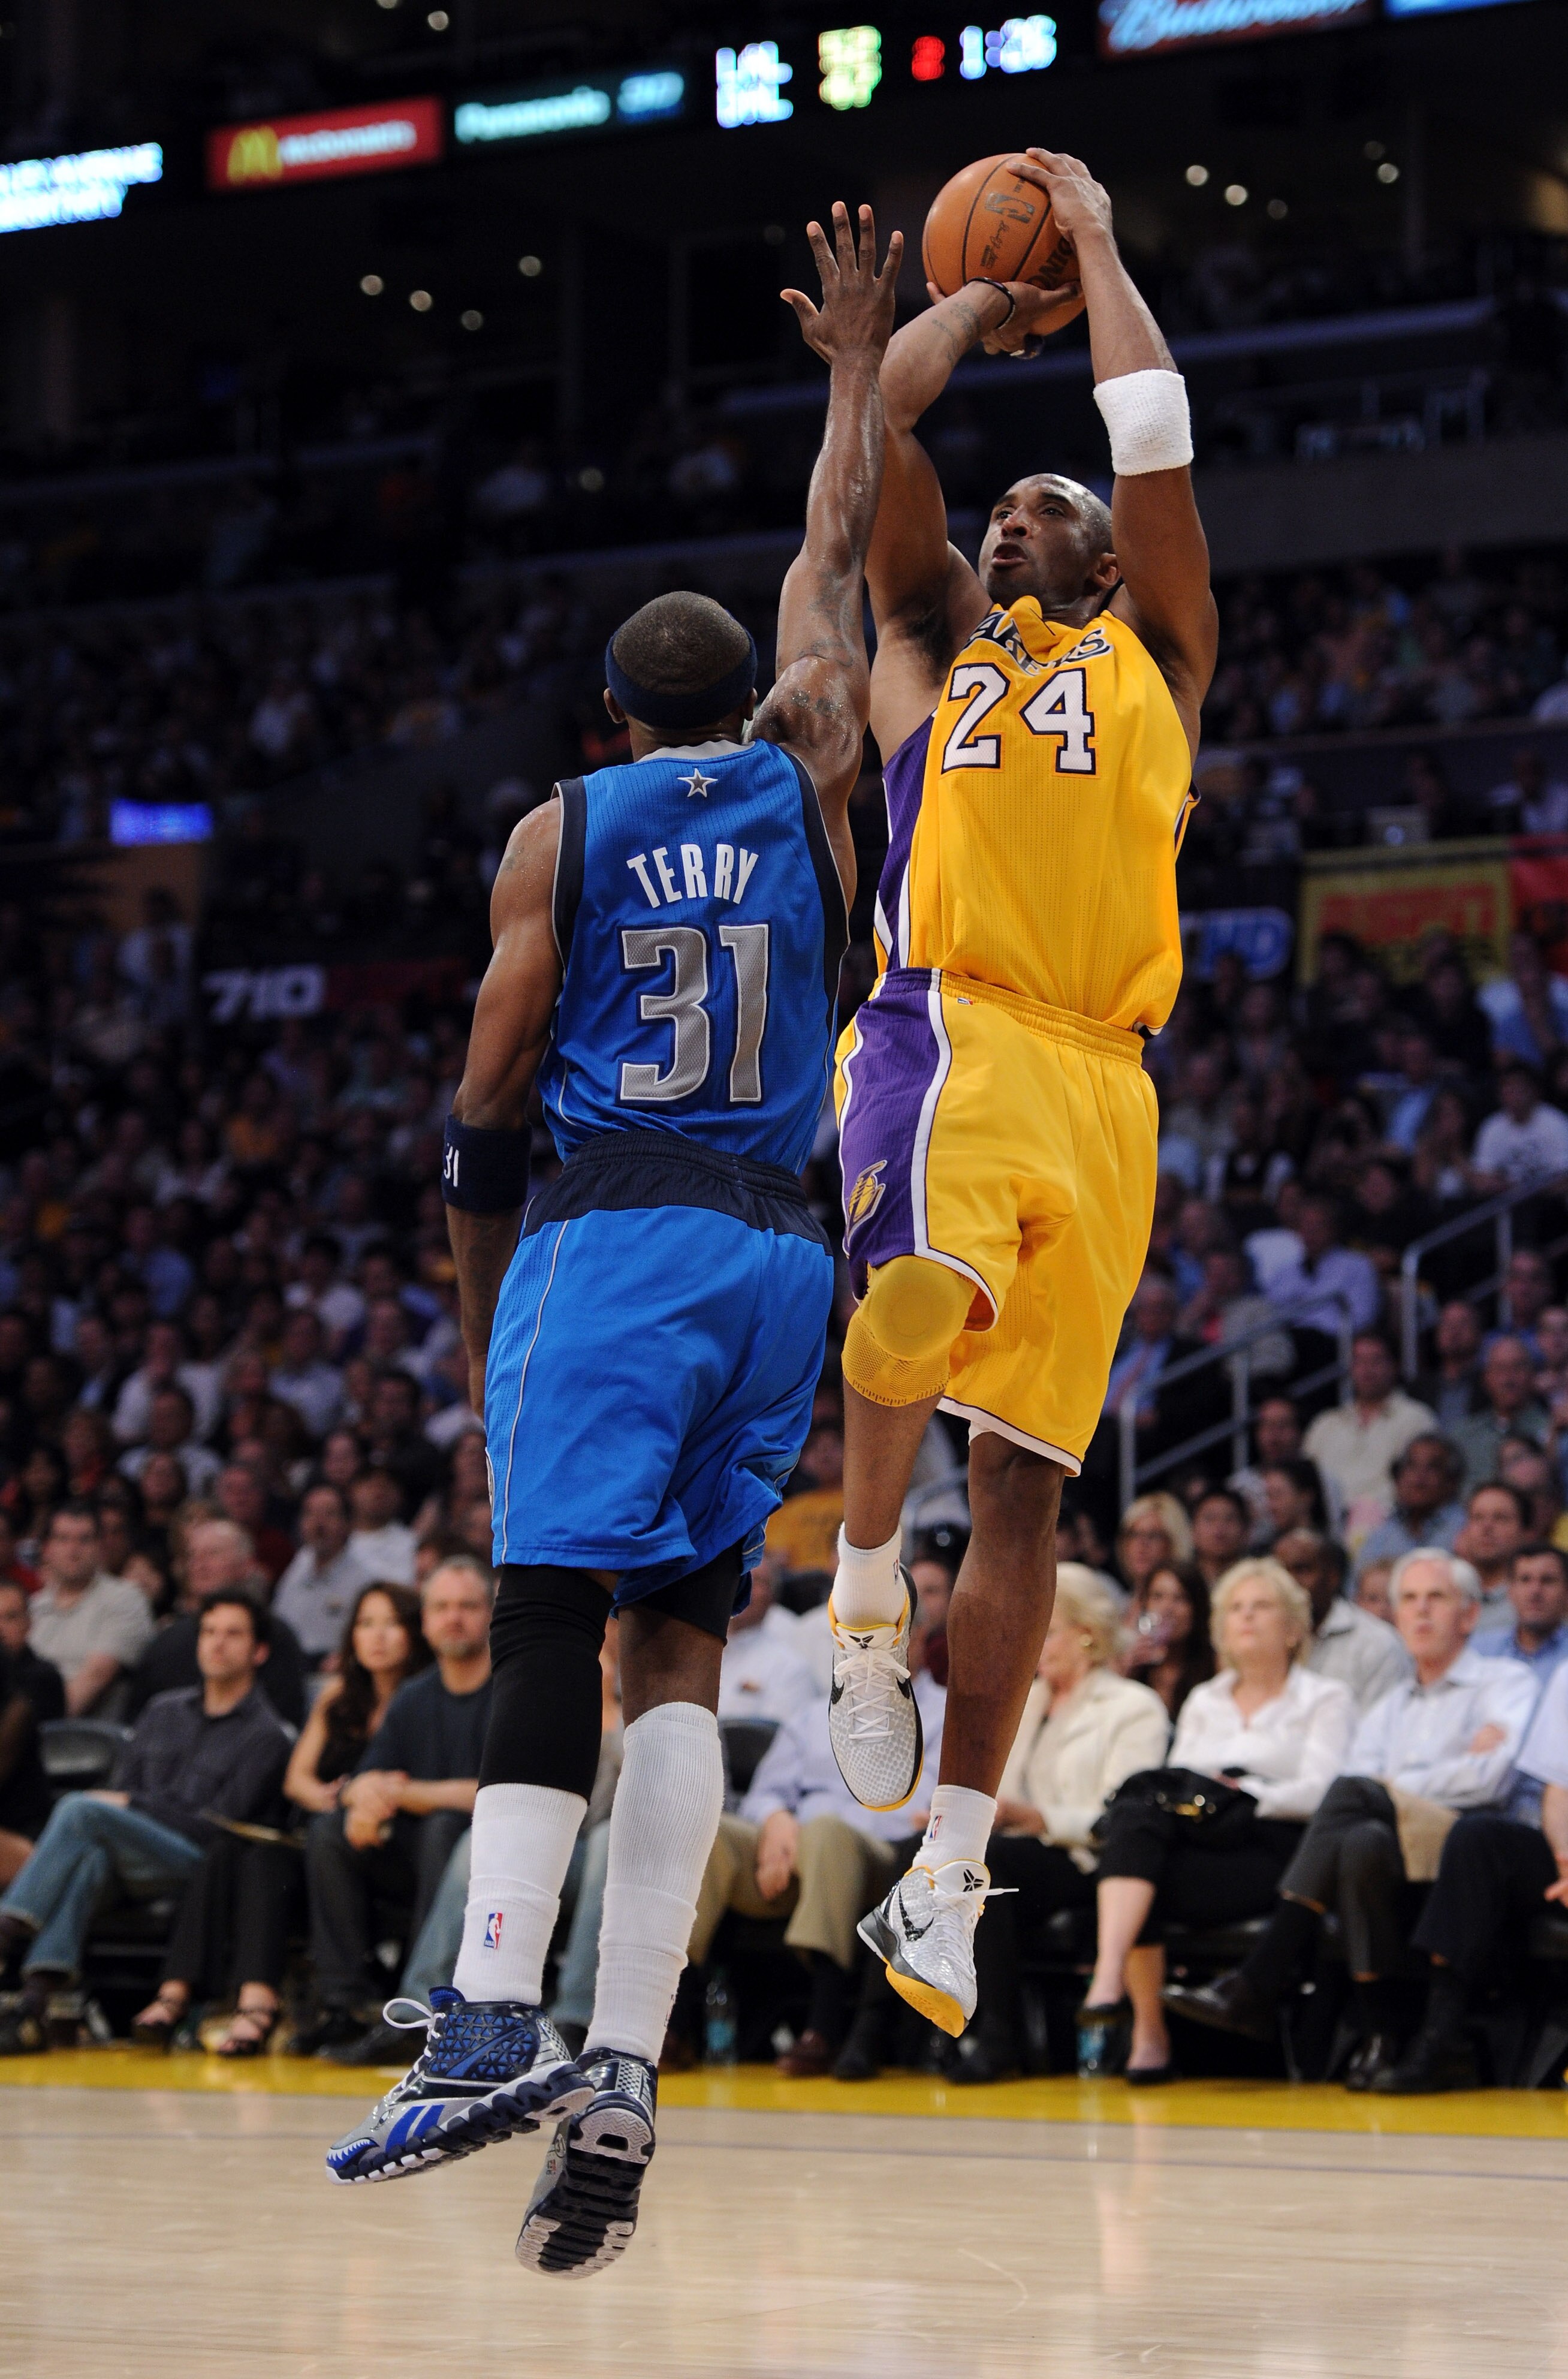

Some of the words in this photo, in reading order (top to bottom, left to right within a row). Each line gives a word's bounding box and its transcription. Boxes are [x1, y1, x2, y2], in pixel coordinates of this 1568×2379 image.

[941, 662, 1096, 775] 24
[627, 844, 759, 908] TERRY
[620, 924, 769, 1102] 31
